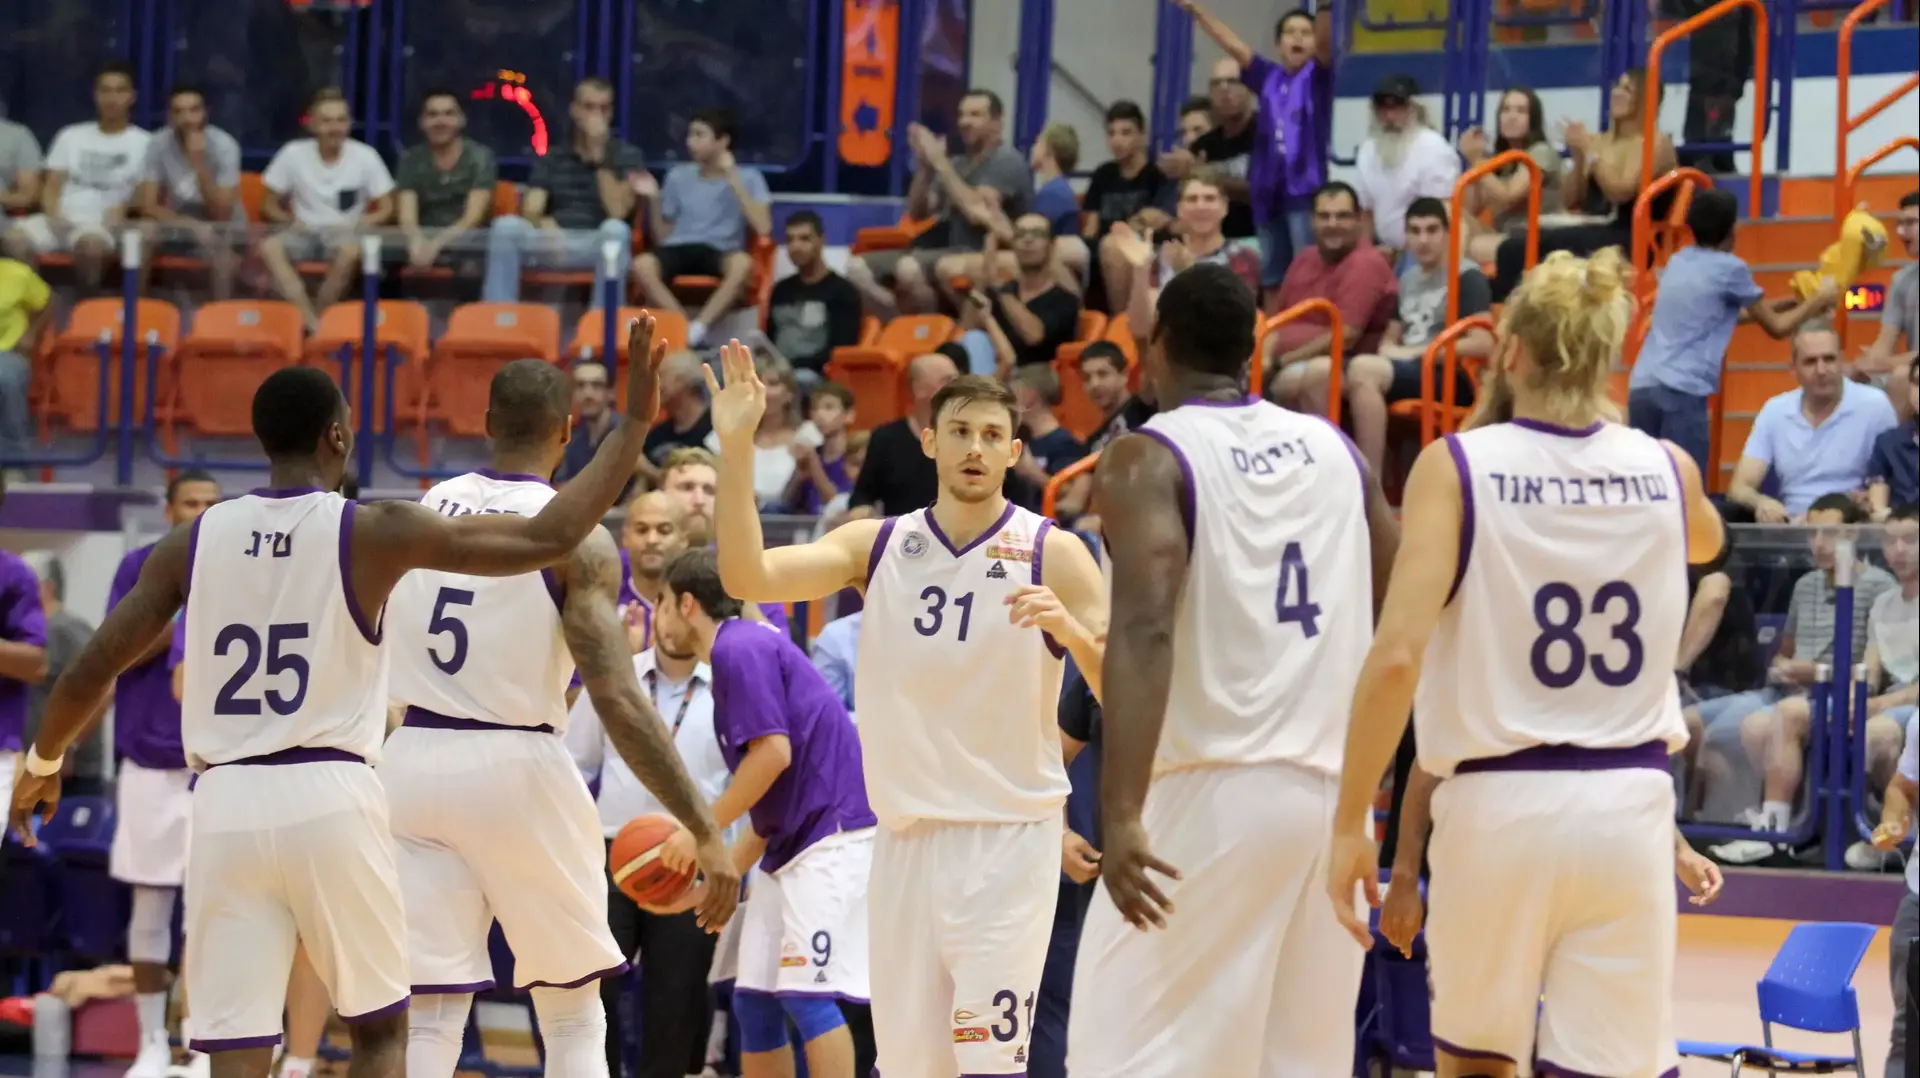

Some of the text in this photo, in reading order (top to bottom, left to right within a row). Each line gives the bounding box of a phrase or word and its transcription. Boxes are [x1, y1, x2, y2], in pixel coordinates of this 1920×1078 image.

[427, 586, 475, 676] 5
[914, 585, 974, 642] 31
[1275, 541, 1322, 638] 4
[1530, 580, 1644, 689] 83
[213, 622, 310, 716] 25
[811, 930, 832, 967] 9
[990, 989, 1034, 1042] 31
